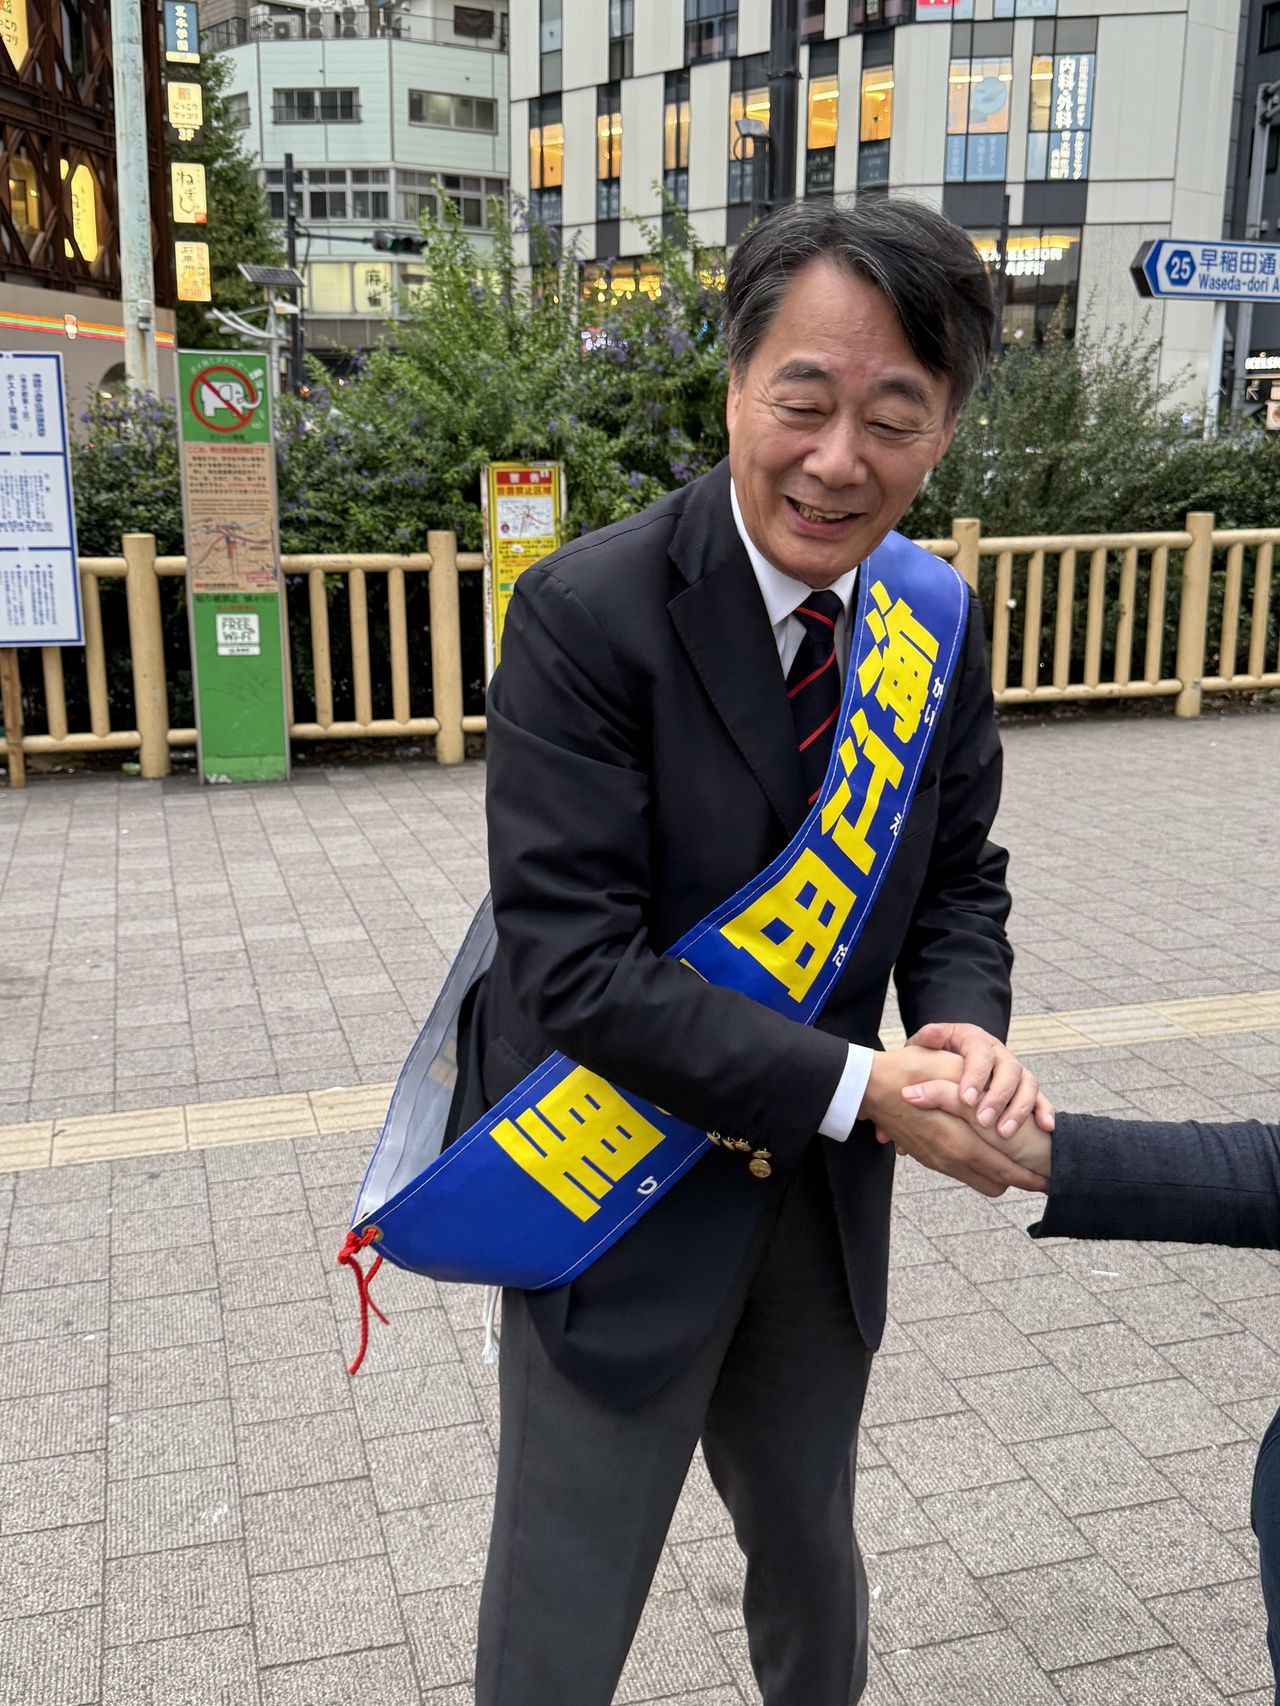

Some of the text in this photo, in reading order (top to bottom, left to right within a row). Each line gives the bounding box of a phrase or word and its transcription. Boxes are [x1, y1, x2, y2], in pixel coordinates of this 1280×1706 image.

[1055, 56, 1076, 129] 内科・外科
[176, 169, 197, 214] ねぎし
[1170, 257, 1192, 280] 25
[1199, 249, 1280, 276] 早稲田通
[366, 269, 382, 308] 麻雀
[1199, 274, 1268, 292] Waseda-dori
[222, 620, 250, 631] FREE
[720, 580, 939, 1003] 海江田
